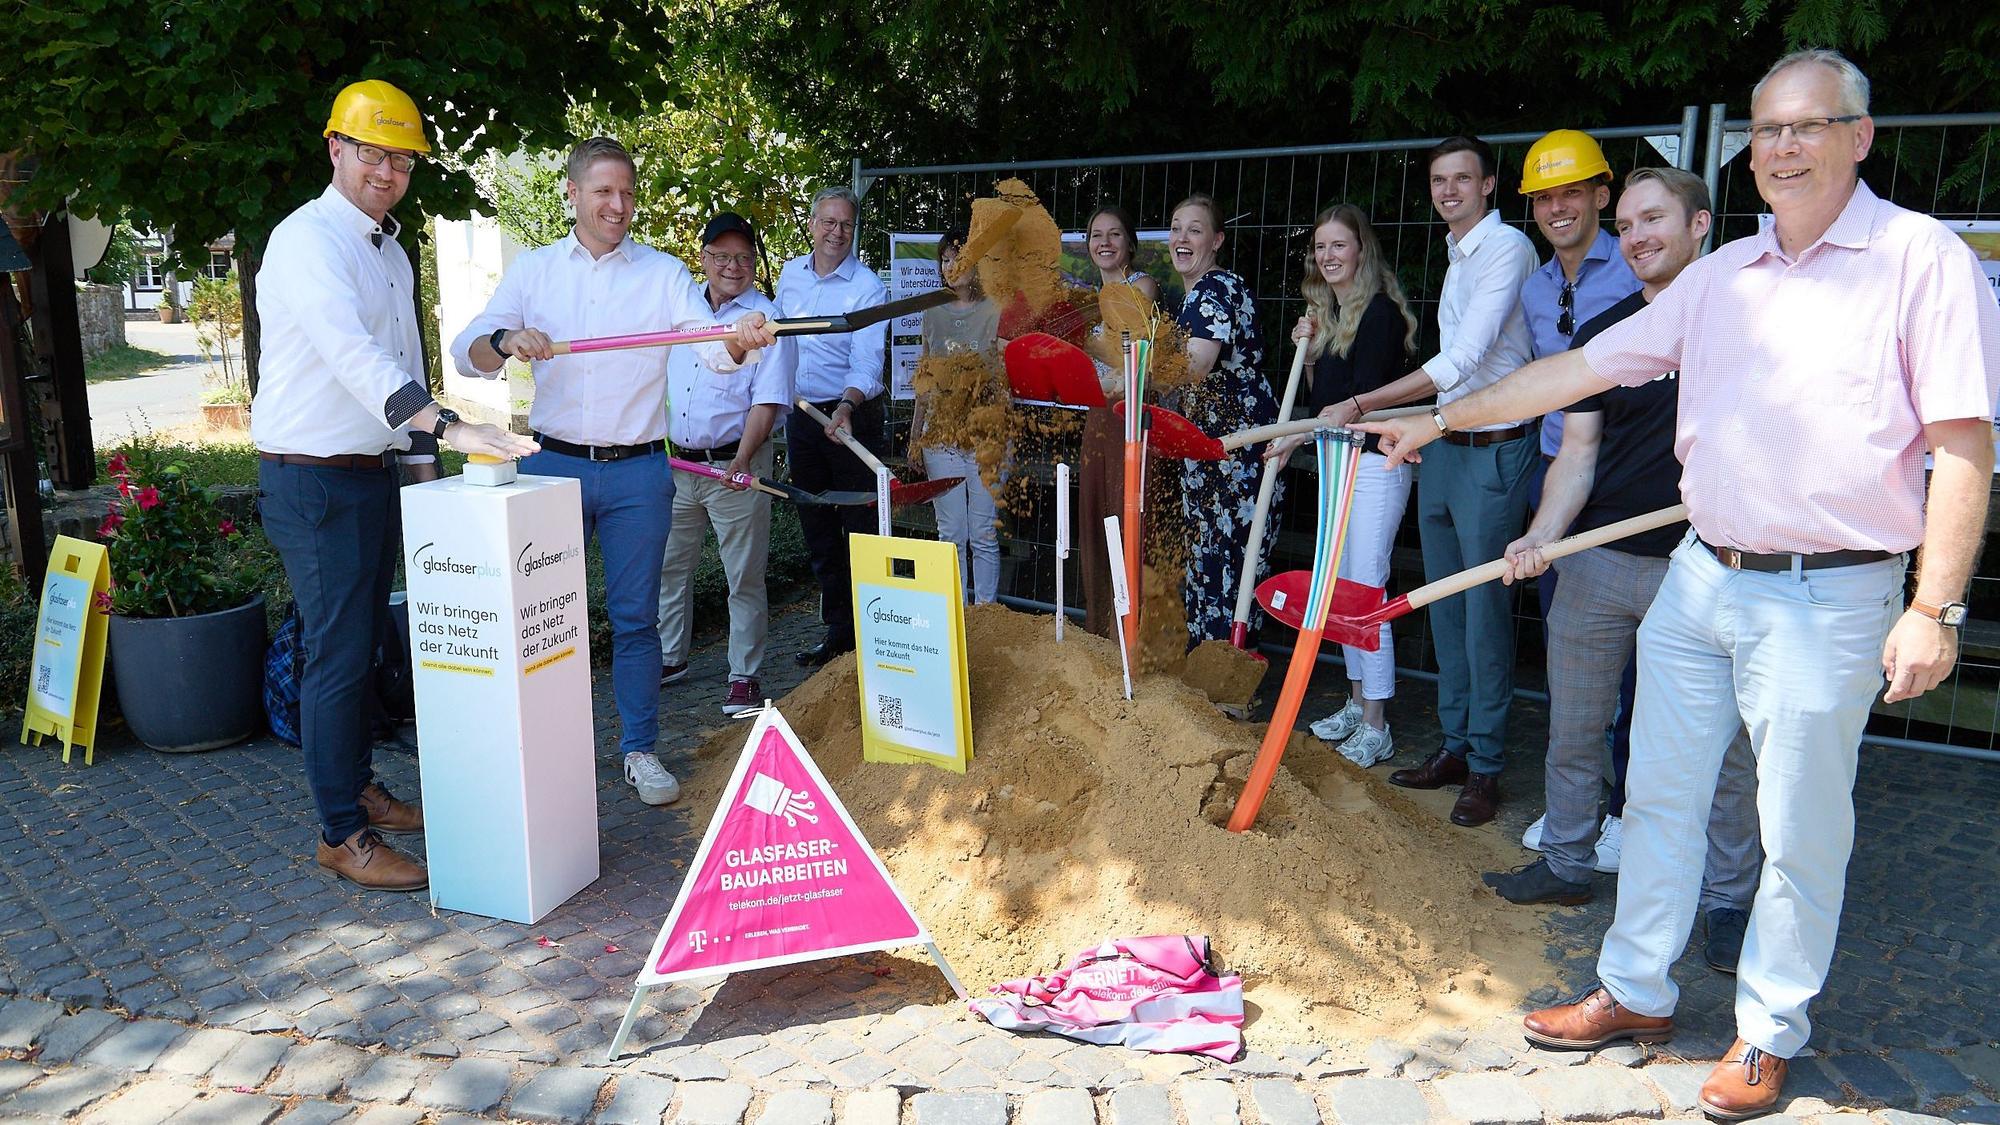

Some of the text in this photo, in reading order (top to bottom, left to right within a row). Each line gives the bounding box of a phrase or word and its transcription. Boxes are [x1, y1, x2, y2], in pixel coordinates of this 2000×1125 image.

[900, 266, 913, 276] Wir
[423, 555, 502, 580] glasfaserplus
[524, 544, 579, 577] glasfaserplus
[416, 602, 498, 624] Wir bringen
[520, 590, 577, 620] Wir bringen
[418, 621, 478, 639] das Netz
[522, 614, 564, 639] das Netz
[873, 607, 930, 630] glasfaserplus
[420, 640, 499, 660] der Zukunft
[522, 626, 578, 658] der Zukunft
[874, 637, 939, 655] Hier kommt das Netz
[875, 648, 910, 661] der Zukunft
[725, 838, 839, 868] GLASFASER-
[720, 858, 848, 891] BAUARBEITEN
[728, 888, 844, 911] telekom.de/jetzt-glasfaser
